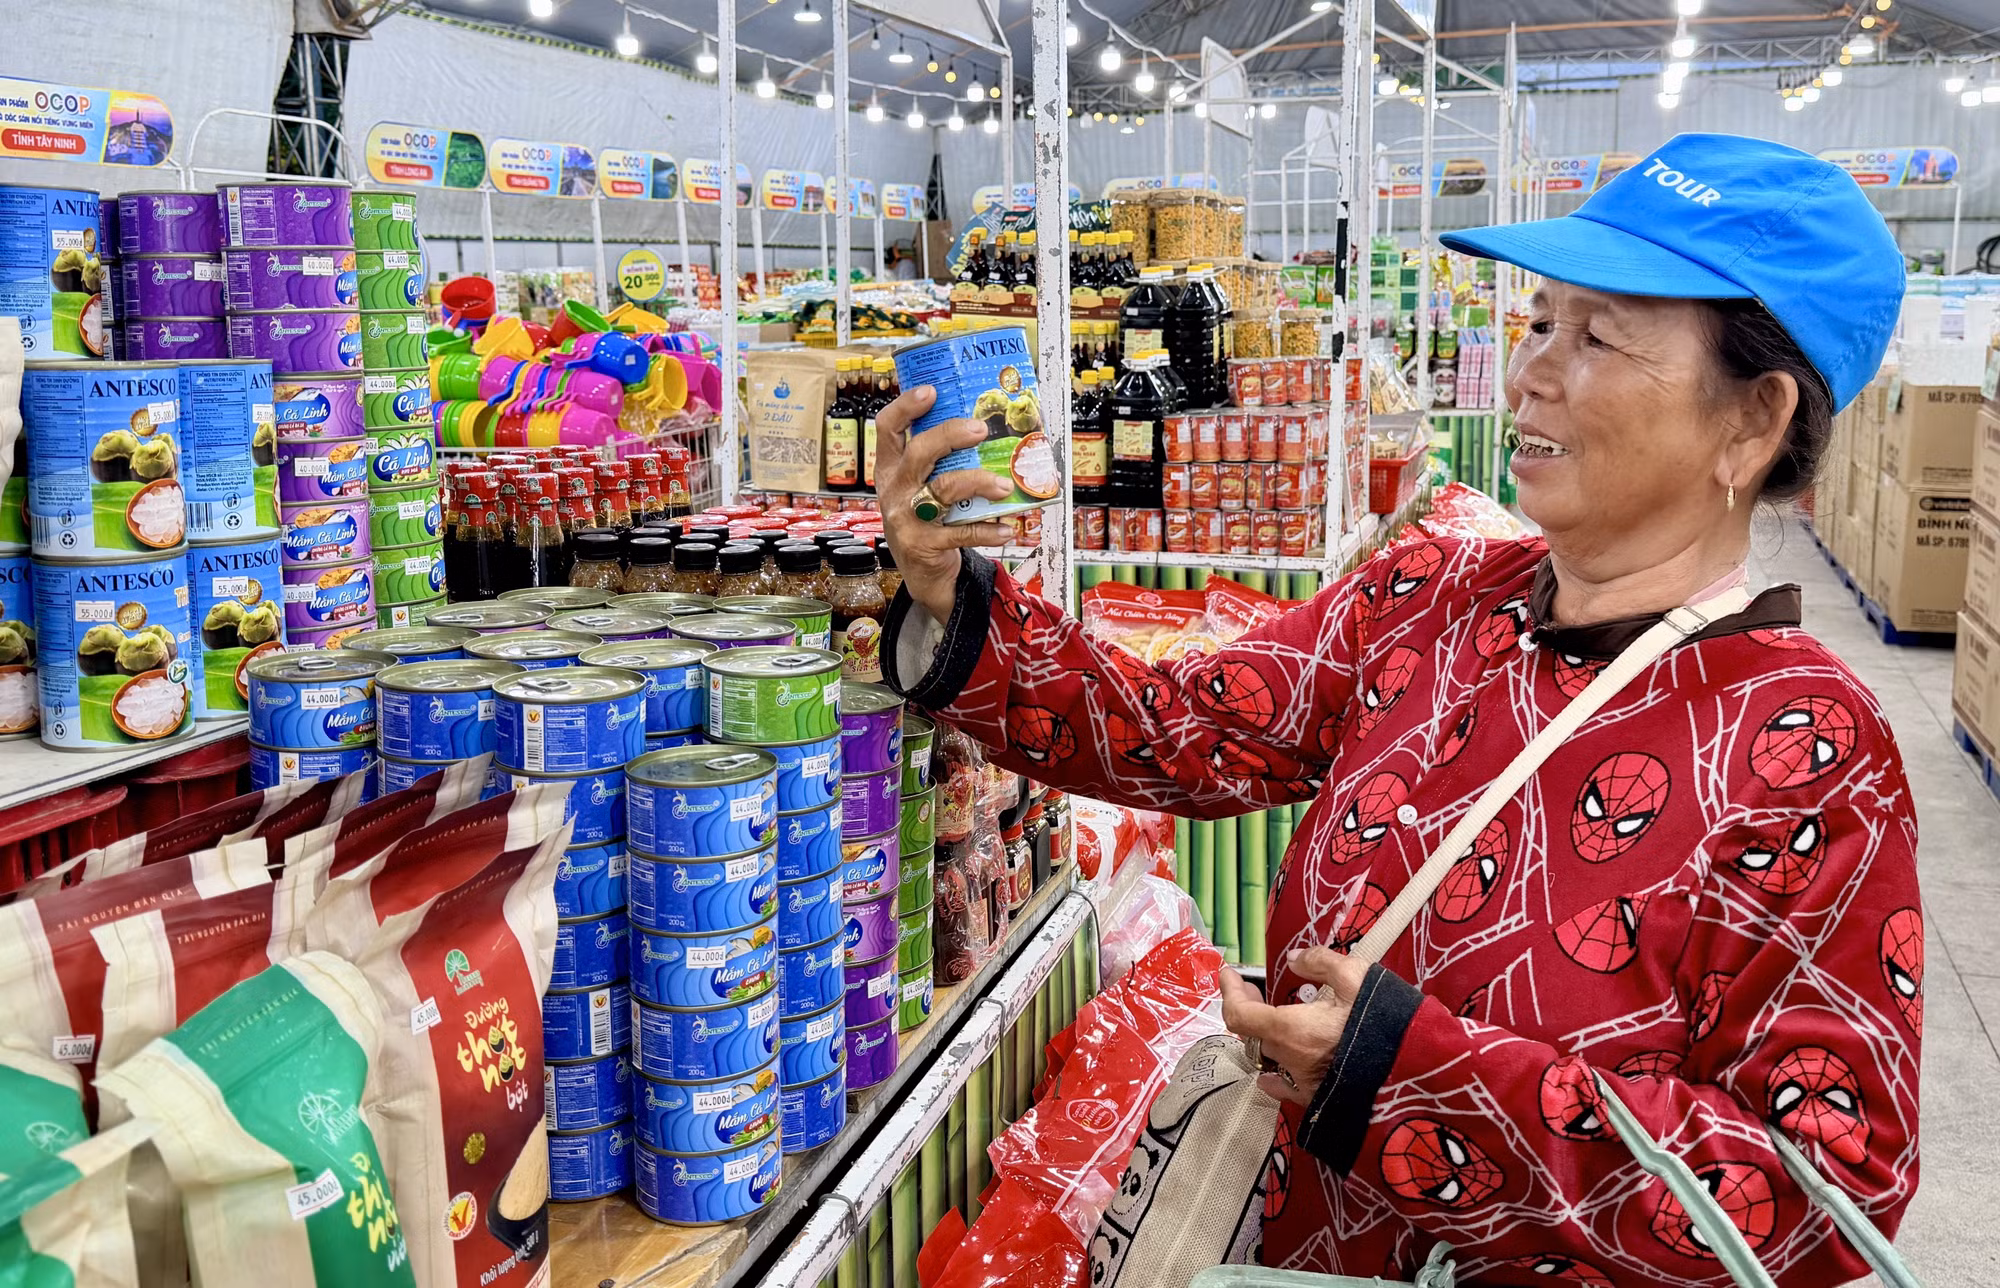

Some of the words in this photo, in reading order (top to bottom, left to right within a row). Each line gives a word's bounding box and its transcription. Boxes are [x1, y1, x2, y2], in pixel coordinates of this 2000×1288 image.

[35, 91, 90, 114] OCOP
[12, 131, 34, 146] TỈNH
[36, 135, 53, 148] TÂY
[54, 138, 76, 149] NINH
[405, 133, 437, 150] OCOP
[522, 147, 552, 162] OCOP
[1550, 159, 1589, 171] OCOP
[1643, 157, 1722, 208] TOUR
[308, 262, 332, 270] 40.000đ
[199, 270, 222, 279] 40.000
[624, 276, 642, 289] 20
[1237, 366, 1250, 375] KTC
[89, 378, 176, 398] ANTESCO
[370, 380, 396, 389] 44.000đ
[397, 396, 415, 411] Cá
[284, 409, 299, 420] Cá
[302, 404, 328, 419] Linh
[379, 454, 400, 473] Cá
[404, 445, 430, 471] Linh
[299, 464, 327, 473] 40.000đ
[321, 470, 345, 484] Mắm
[347, 466, 358, 478] Cá
[1255, 515, 1268, 523] KTC
[1282, 515, 1295, 523] KTC
[1917, 514, 1951, 530] BÌNH
[287, 535, 314, 549] Mắm
[317, 530, 333, 543] Cá
[336, 526, 356, 541] Linh
[200, 548, 279, 573] ANTESCO
[76, 568, 174, 593] ANTESCO
[218, 584, 247, 594] 55.000đ
[286, 591, 314, 600] 40.000đ
[309, 596, 337, 610] Mắm
[339, 591, 352, 604] Cá
[354, 585, 369, 600] Linh
[81, 608, 113, 619] 55.000đ
[1107, 607, 1122, 617] Nui
[1124, 610, 1145, 619] Chiên
[306, 693, 338, 704] 44.000đ
[327, 713, 358, 729] Mắm
[425, 748, 436, 756] 200
[735, 801, 760, 813] 44.000đ
[731, 863, 757, 875] 44.000đ
[848, 868, 861, 880] Cá
[864, 858, 885, 878] Linh
[752, 884, 771, 901] Mắm
[692, 951, 724, 962] 44.000đ
[715, 968, 745, 984] Mắm
[747, 958, 760, 973] Cá
[464, 997, 509, 1029] Đường
[58, 1043, 92, 1057] 45.000đ
[457, 1014, 518, 1073] thốt
[479, 1042, 527, 1093] nốt
[506, 1078, 528, 1112] bột
[699, 1094, 731, 1107] 44.000đ
[719, 1114, 748, 1131] Mắm
[751, 1103, 764, 1119] Cá
[729, 1162, 757, 1176] 44.000đ
[752, 1172, 772, 1192] Mắm
[298, 1179, 338, 1207] 45.000đ
[480, 1264, 497, 1286] Khối
[497, 1255, 516, 1275] lượng
